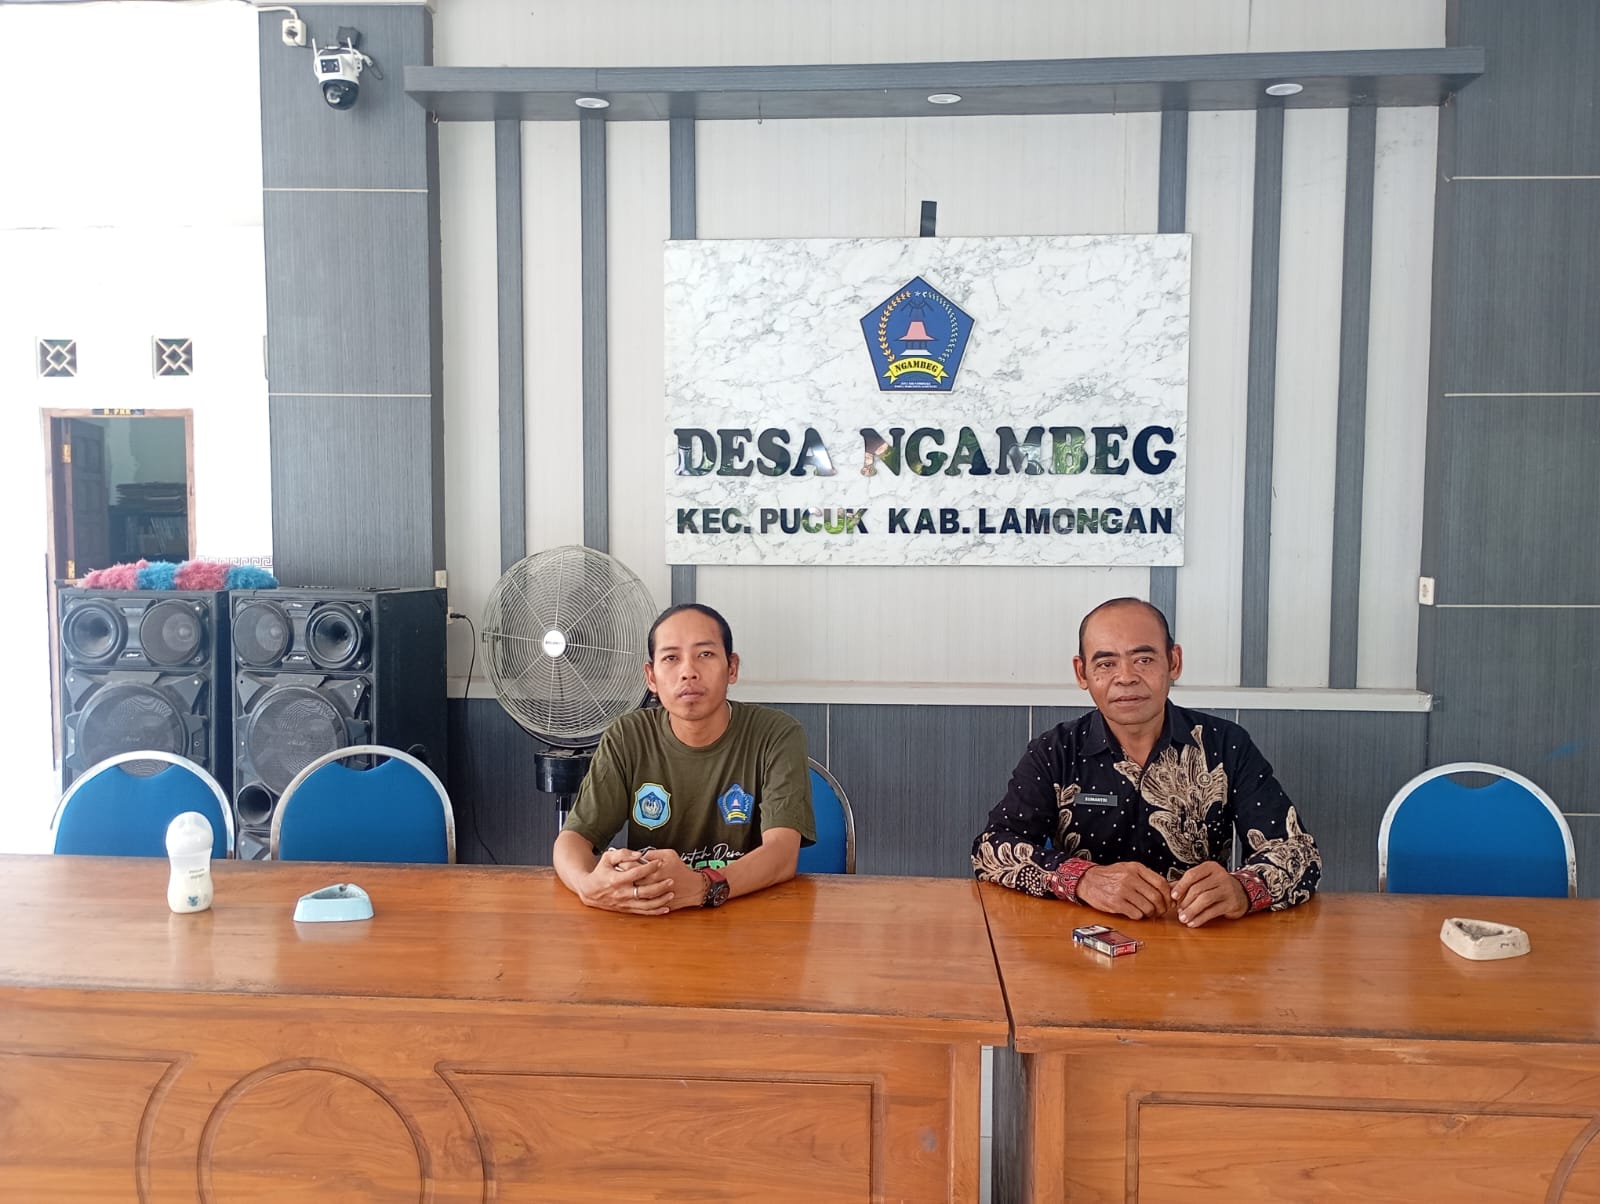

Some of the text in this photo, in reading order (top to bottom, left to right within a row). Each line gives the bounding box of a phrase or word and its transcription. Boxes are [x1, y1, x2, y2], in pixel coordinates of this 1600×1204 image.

[895, 361, 938, 373] NGAMBEG
[674, 426, 1178, 476] DESA NGAMBEG
[713, 842, 745, 861] Desa
